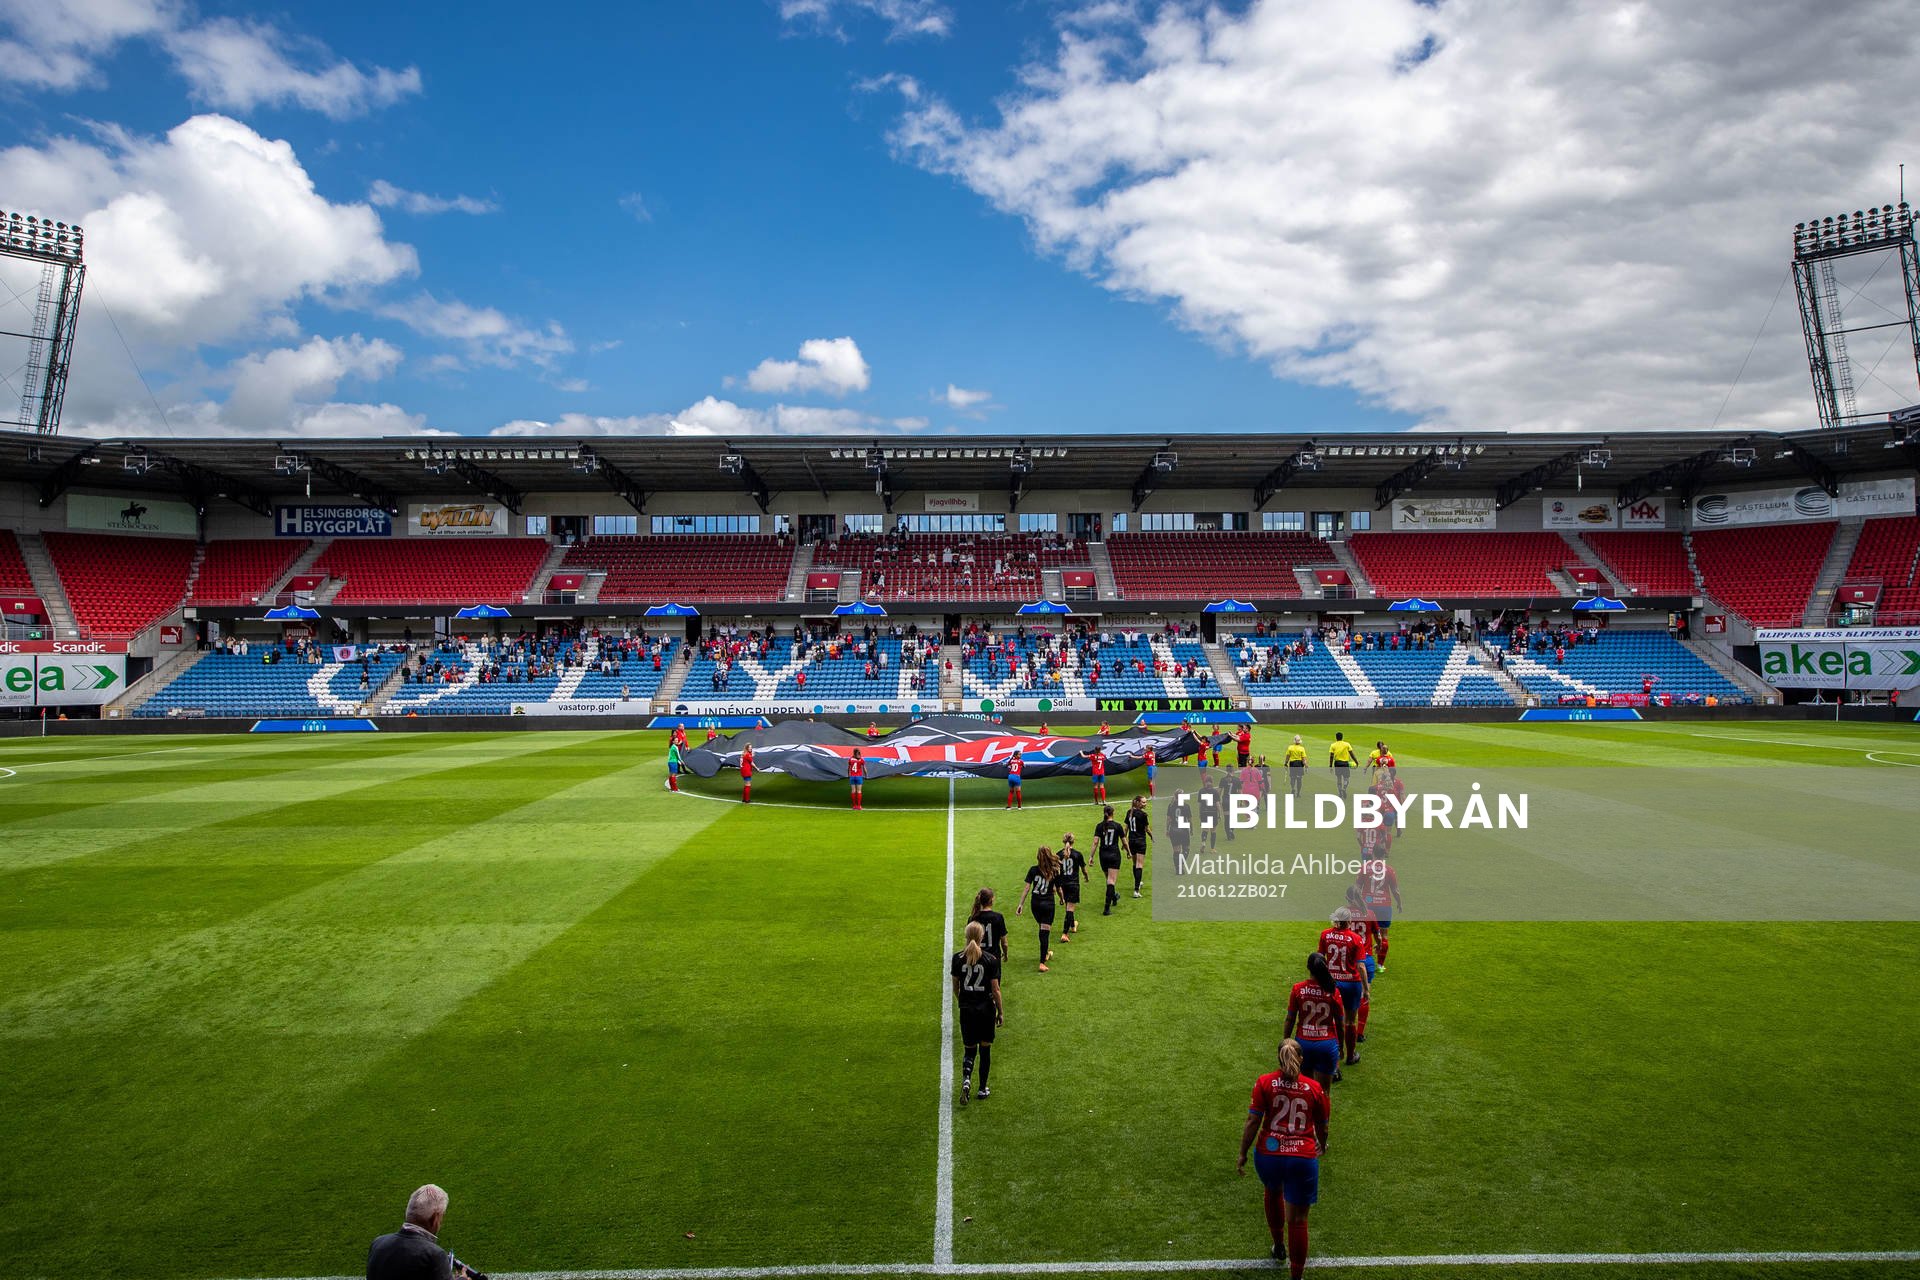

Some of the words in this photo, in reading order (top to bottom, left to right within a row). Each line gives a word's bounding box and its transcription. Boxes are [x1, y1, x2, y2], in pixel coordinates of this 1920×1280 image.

[1846, 492, 1905, 503] CASTELLUM
[1630, 501, 1660, 519] MAX
[1735, 501, 1789, 511] CASTELLUM
[281, 508, 385, 532] HELSINGBORGS
[304, 518, 385, 533] BYGGPLÅT
[420, 509, 495, 530] WALLIN
[1104, 614, 1145, 626] hjärtan
[53, 641, 106, 653] Scandic
[1764, 643, 1872, 676] akea
[0, 666, 65, 692] ea
[558, 702, 616, 713] vasatorp.golf
[995, 699, 1015, 707] Solid
[1053, 699, 1073, 707] Solid
[852, 762, 858, 773] 4
[1010, 763, 1019, 772] 10
[1363, 829, 1377, 844] 10
[1325, 932, 1344, 940] akea
[1327, 943, 1347, 971] 21
[961, 964, 985, 992] 22
[1300, 986, 1322, 996] akea
[1302, 1000, 1330, 1026] 22
[1271, 1077, 1298, 1090] akea
[1270, 1094, 1308, 1133] 26
[1280, 1145, 1298, 1153] Bank
